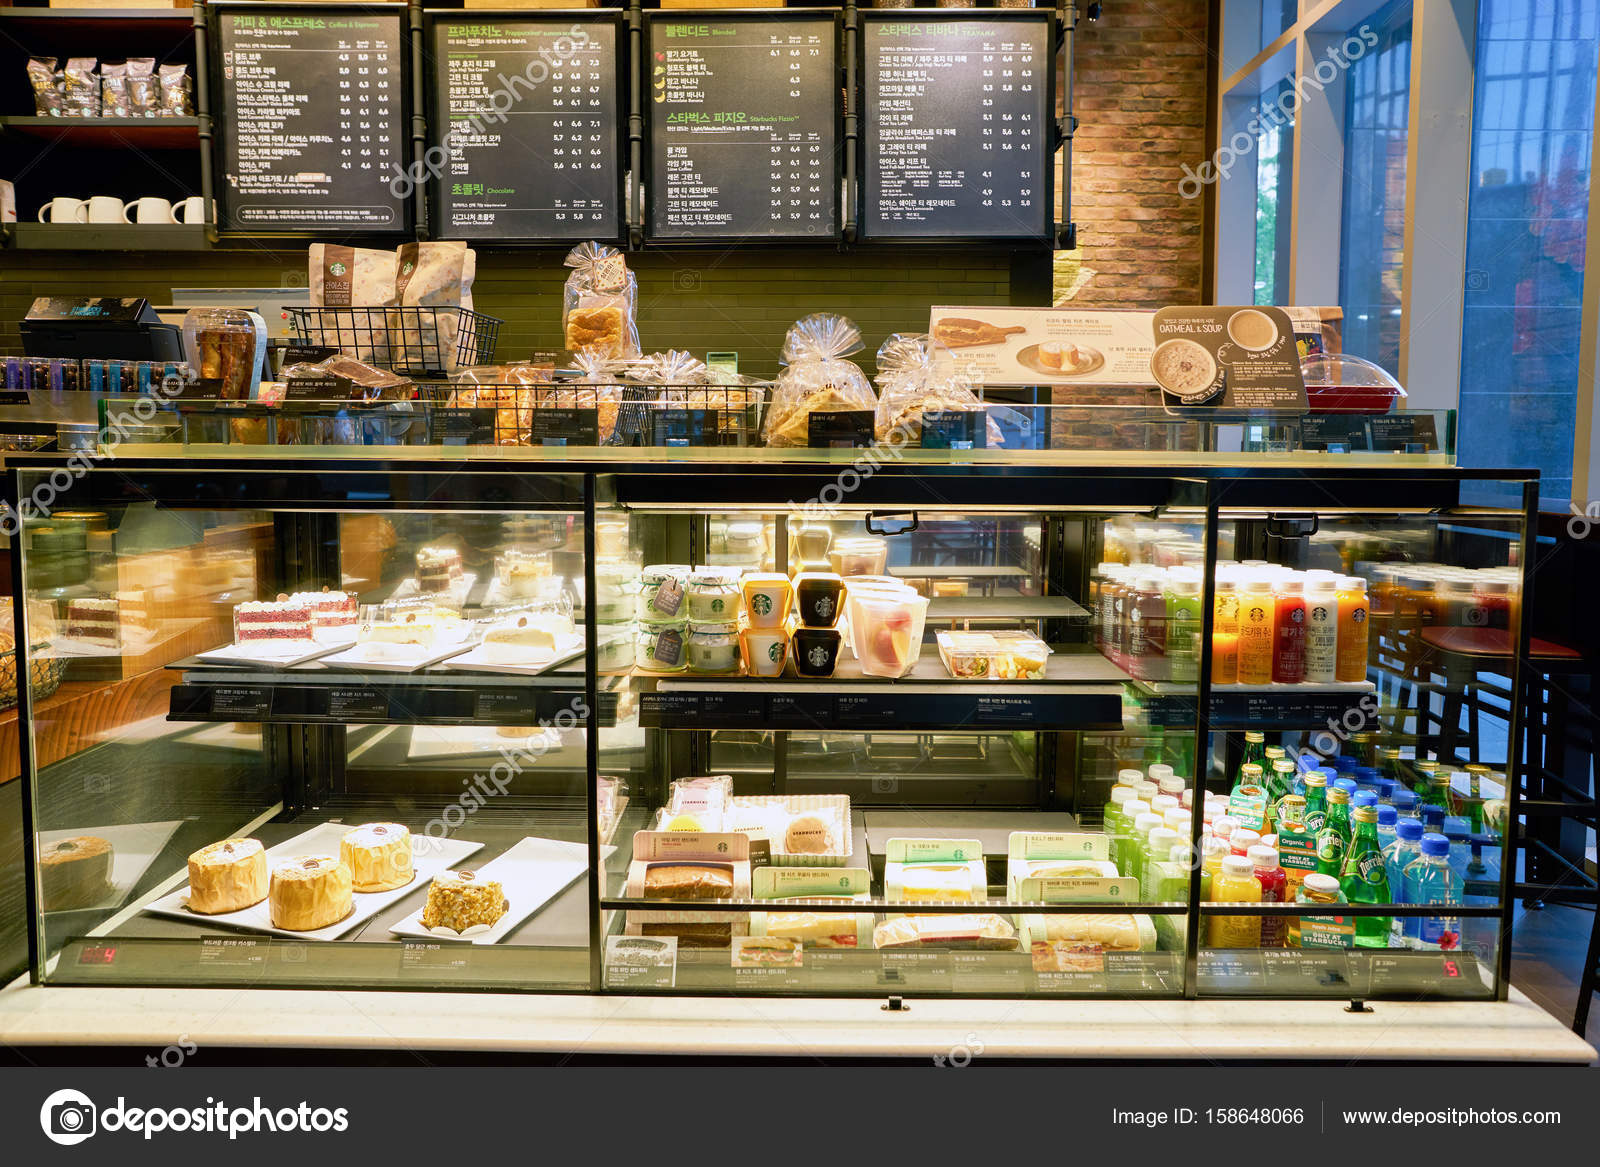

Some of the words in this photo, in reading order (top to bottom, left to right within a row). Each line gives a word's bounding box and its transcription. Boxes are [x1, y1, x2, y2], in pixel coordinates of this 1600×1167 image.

[233, 17, 255, 28] 커피
[258, 18, 267, 27] &
[270, 17, 326, 29] 에스프레소
[448, 26, 502, 38] 프라푸치노
[666, 25, 710, 37] 블렌디드
[878, 24, 922, 36] 스타벅스
[926, 24, 959, 36] 티바나
[666, 112, 710, 124] 스타벅스
[714, 112, 747, 124] 피지오
[452, 184, 483, 195] 초콜릿
[1160, 324, 1195, 333] OATMEAL
[1203, 324, 1222, 333] SOUP
[1281, 838, 1305, 847] Organic
[1281, 858, 1315, 867] STARBUCKS
[1304, 936, 1348, 946] STARBUCKS
[1313, 932, 1330, 940] ONLY
